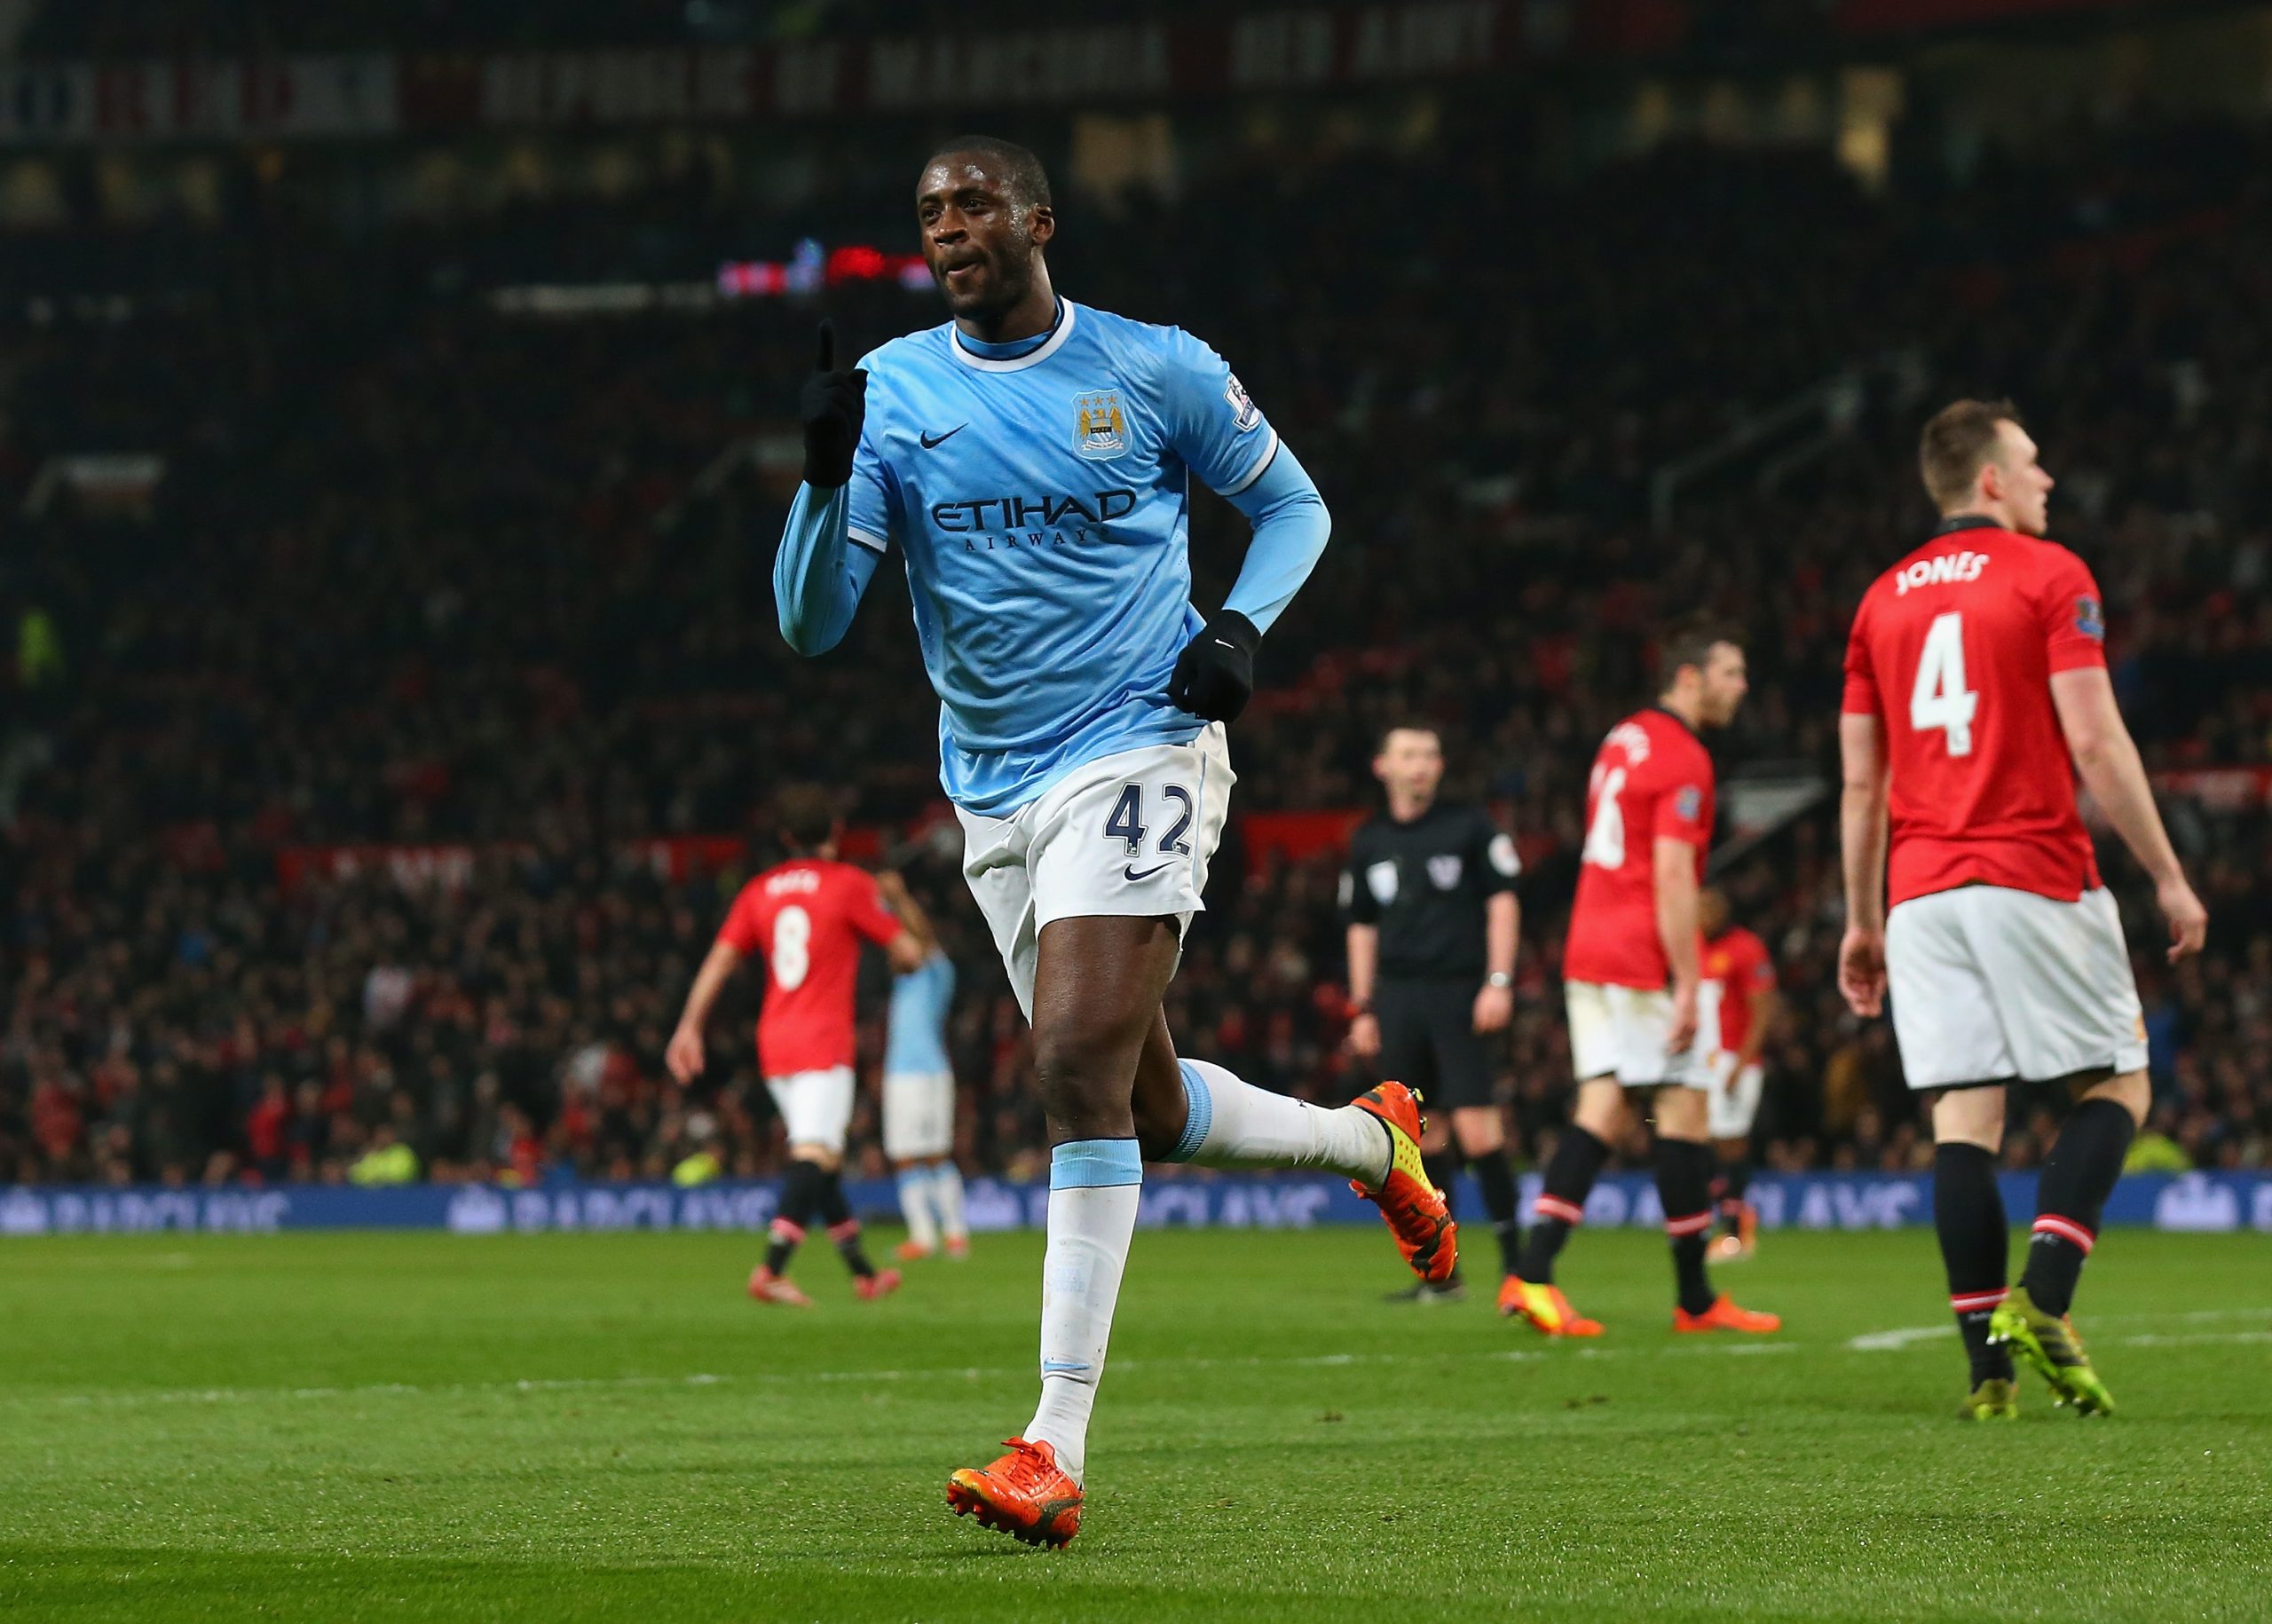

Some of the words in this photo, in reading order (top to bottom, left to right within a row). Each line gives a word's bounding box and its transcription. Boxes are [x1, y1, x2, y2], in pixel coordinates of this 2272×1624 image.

[932, 489, 1136, 532] ETIHAD
[965, 526, 1108, 551] AIRWAY
[1896, 550, 1990, 595] JONES
[1910, 611, 1978, 757] 4
[1102, 782, 1193, 858] 42
[772, 904, 811, 992] 8
